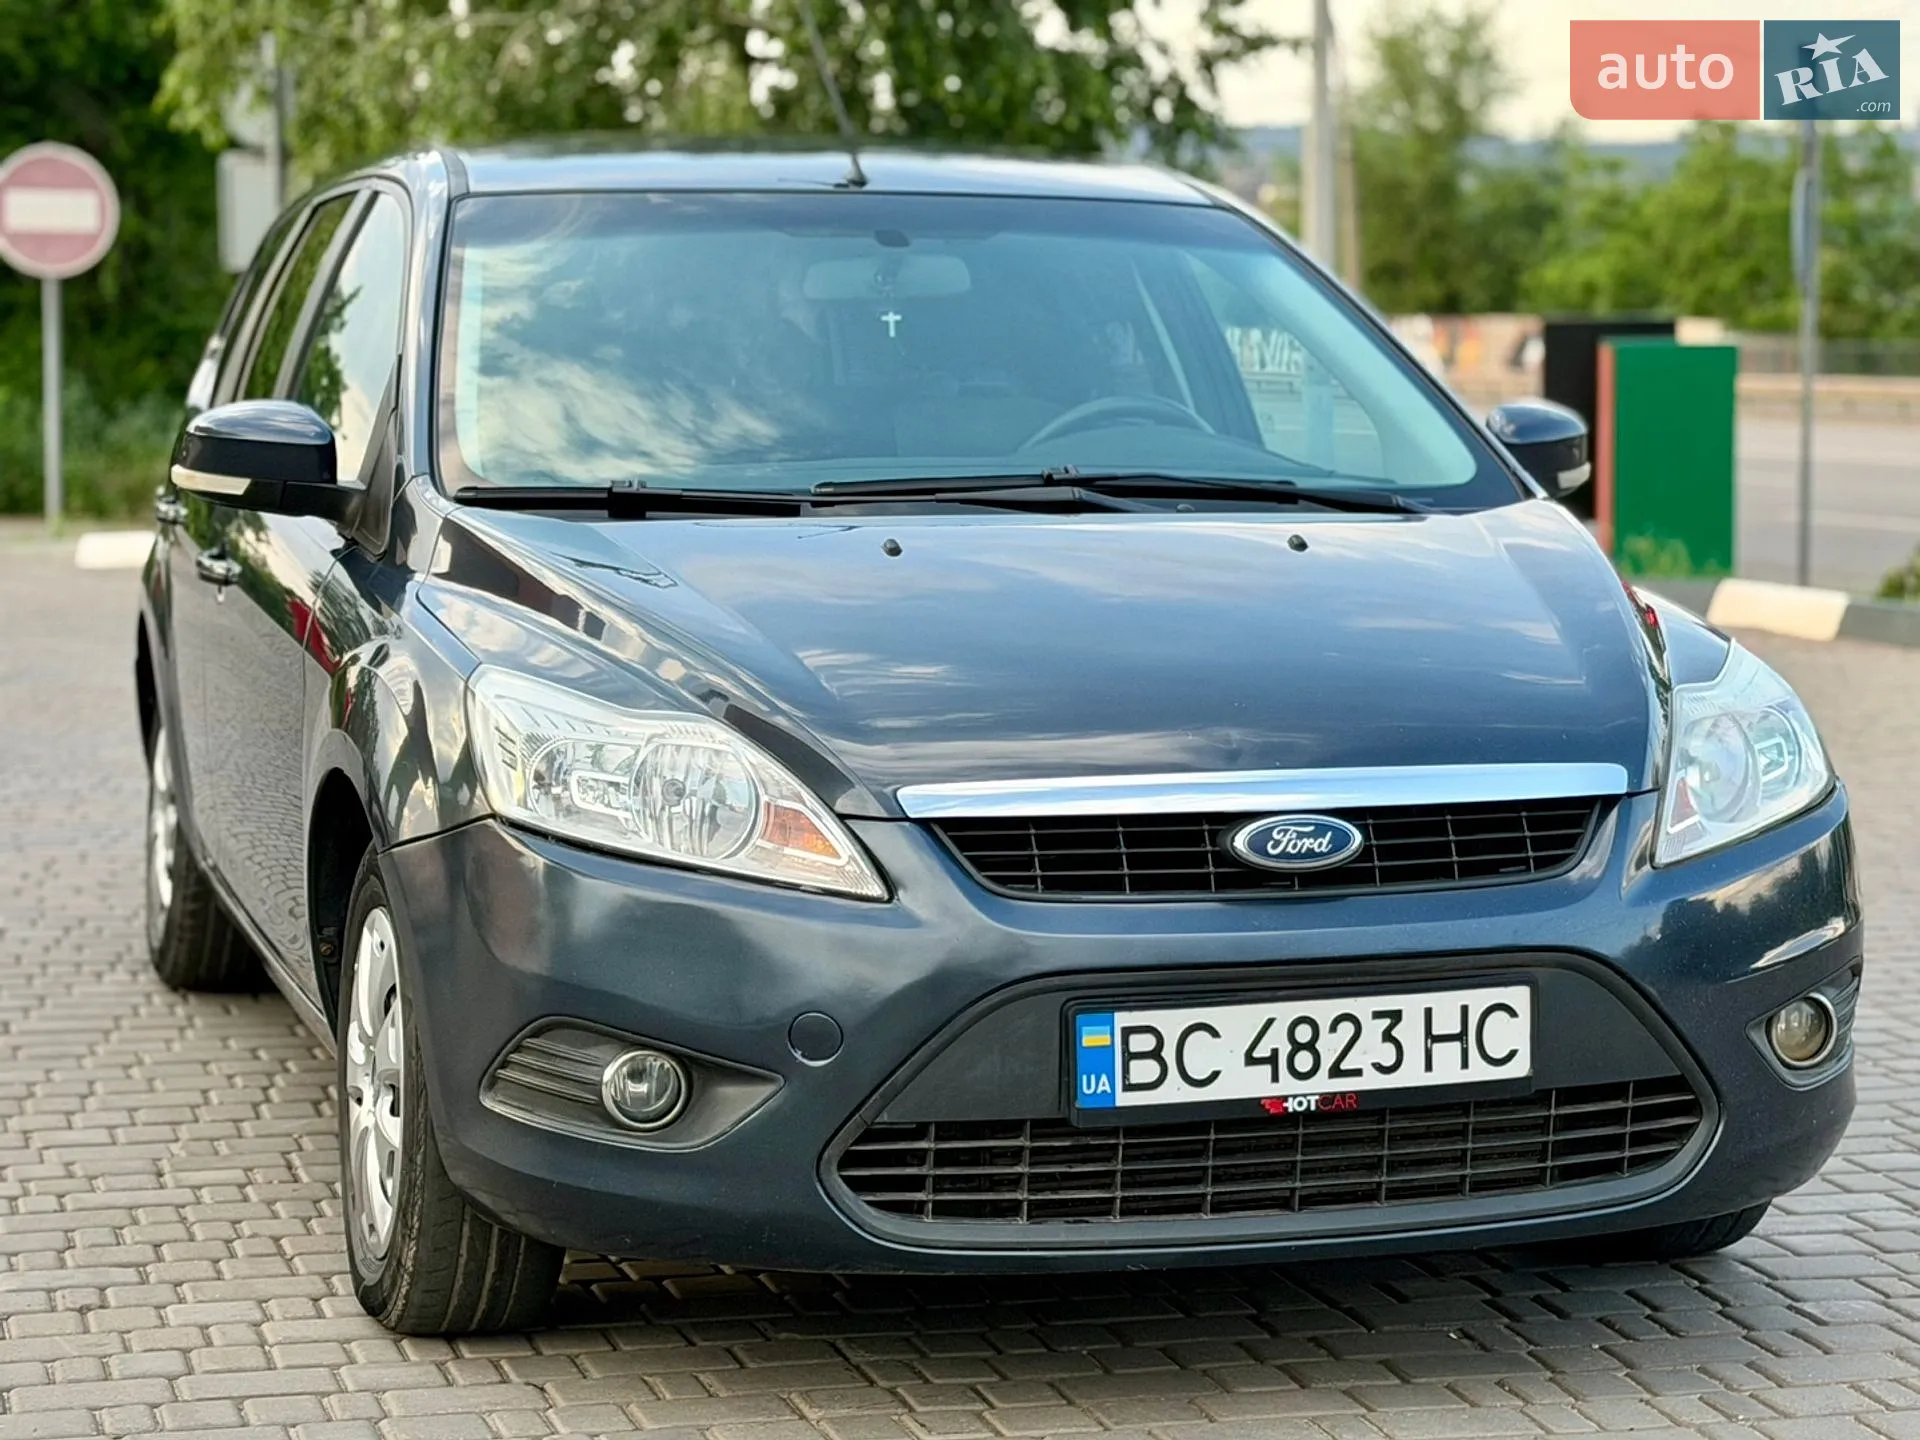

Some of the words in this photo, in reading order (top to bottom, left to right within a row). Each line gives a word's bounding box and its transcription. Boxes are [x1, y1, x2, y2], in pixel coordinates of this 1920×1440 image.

[1266, 825, 1332, 856] Ford
[1120, 1021, 1222, 1093] BC
[1244, 1008, 1404, 1084] 4823
[1423, 1002, 1520, 1073] HC
[1081, 1073, 1112, 1096] UA
